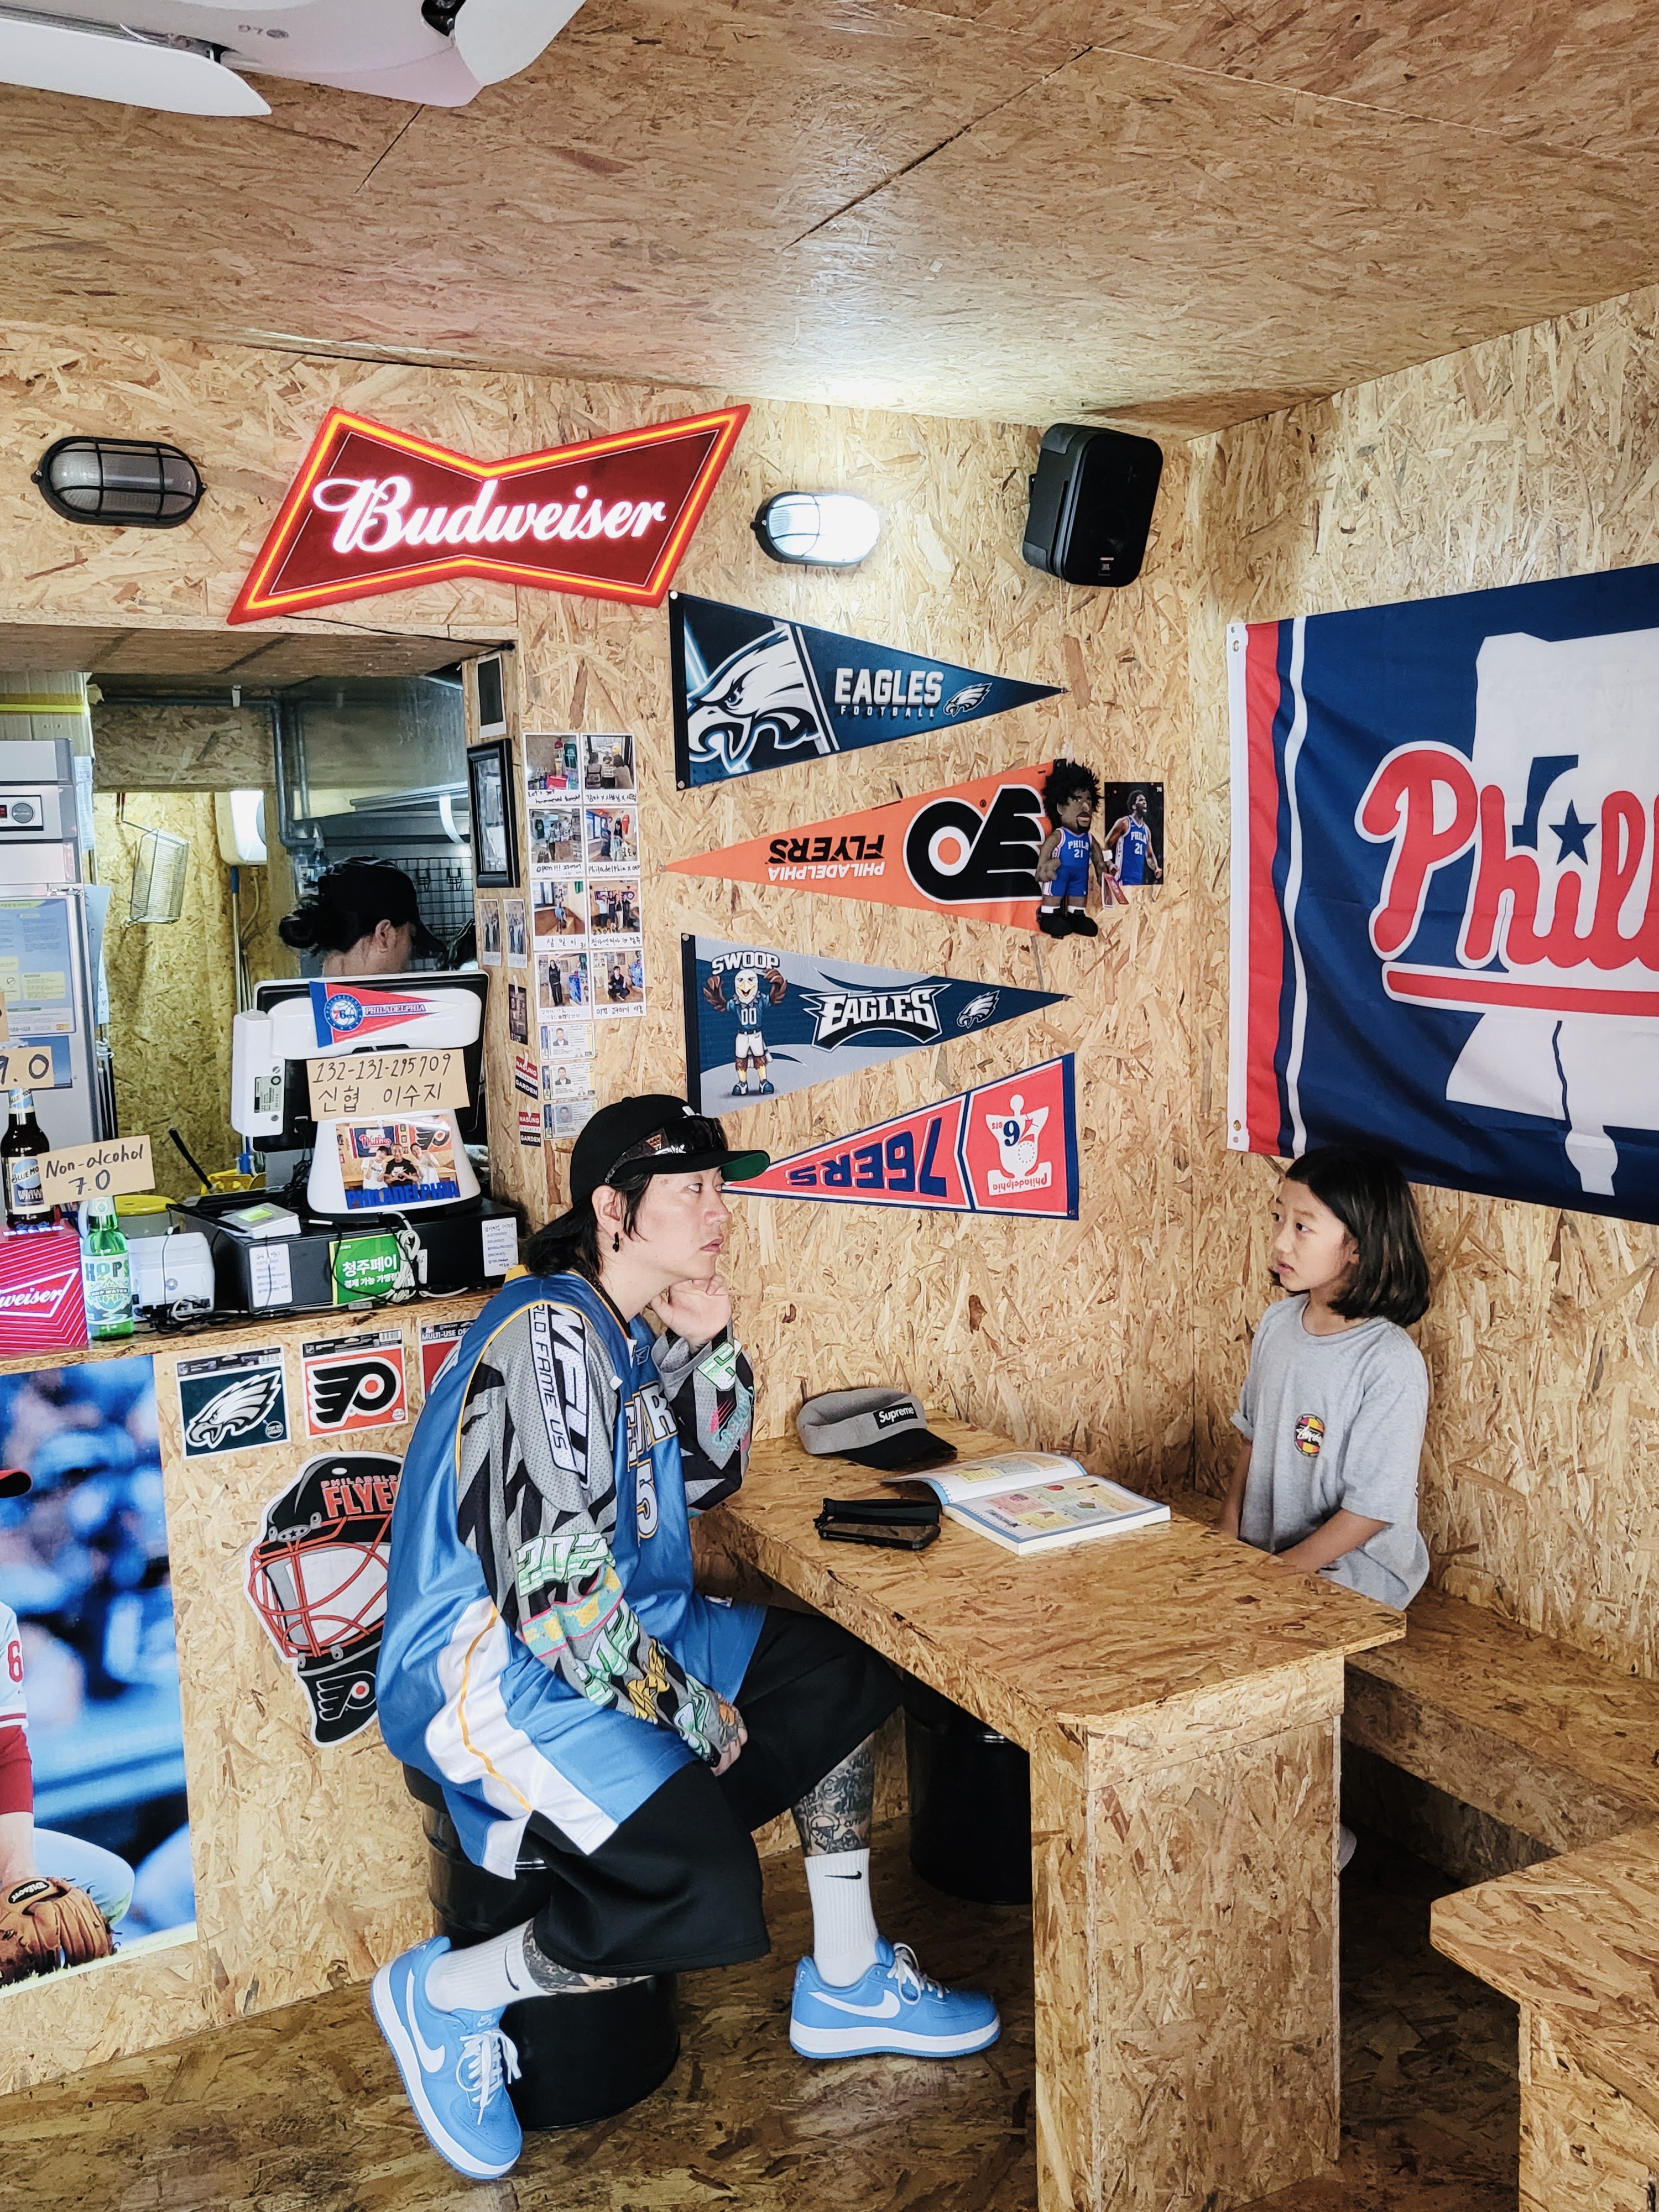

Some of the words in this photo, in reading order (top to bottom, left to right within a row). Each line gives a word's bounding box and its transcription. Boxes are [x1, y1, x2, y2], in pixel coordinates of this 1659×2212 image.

[312, 476, 667, 554] Budweiser
[834, 667, 943, 706] EAGLES
[840, 706, 935, 718] FOOTBALL
[769, 834, 885, 864] FLYERS
[1074, 849, 1083, 858] 21
[1134, 842, 1143, 855] 21
[1355, 740, 1659, 972] Phil
[768, 862, 885, 881] PHILADELPHIA
[711, 951, 780, 975] SWOOP
[365, 1004, 426, 1015] PHILADELPHIA
[740, 1007, 757, 1026] 00
[814, 988, 942, 1044] EAGLES
[318, 1085, 359, 1113] 신협
[383, 1082, 442, 1108] 이수지
[515, 1079, 538, 1097] GARDEN
[520, 1134, 541, 1143] GARDEN
[45, 1143, 144, 1178] Non-alcohol
[785, 1116, 947, 1197] 76ERS
[11, 1171, 29, 1183] BLUE
[68, 1169, 111, 1196] 7.0
[993, 1172, 1047, 1193] Philadelphia
[342, 1254, 398, 1278] 청주페이
[360, 1276, 376, 1286] 가능
[0, 1287, 63, 1308] weiser
[421, 1329, 456, 1341] MULTI-USE
[535, 1341, 557, 1407] FAME
[550, 1418, 568, 1451] US
[878, 1405, 915, 1423] Supreme
[516, 1532, 615, 1598] 202
[8, 1640, 23, 1683] 6
[11, 1881, 48, 1902] Wilson
